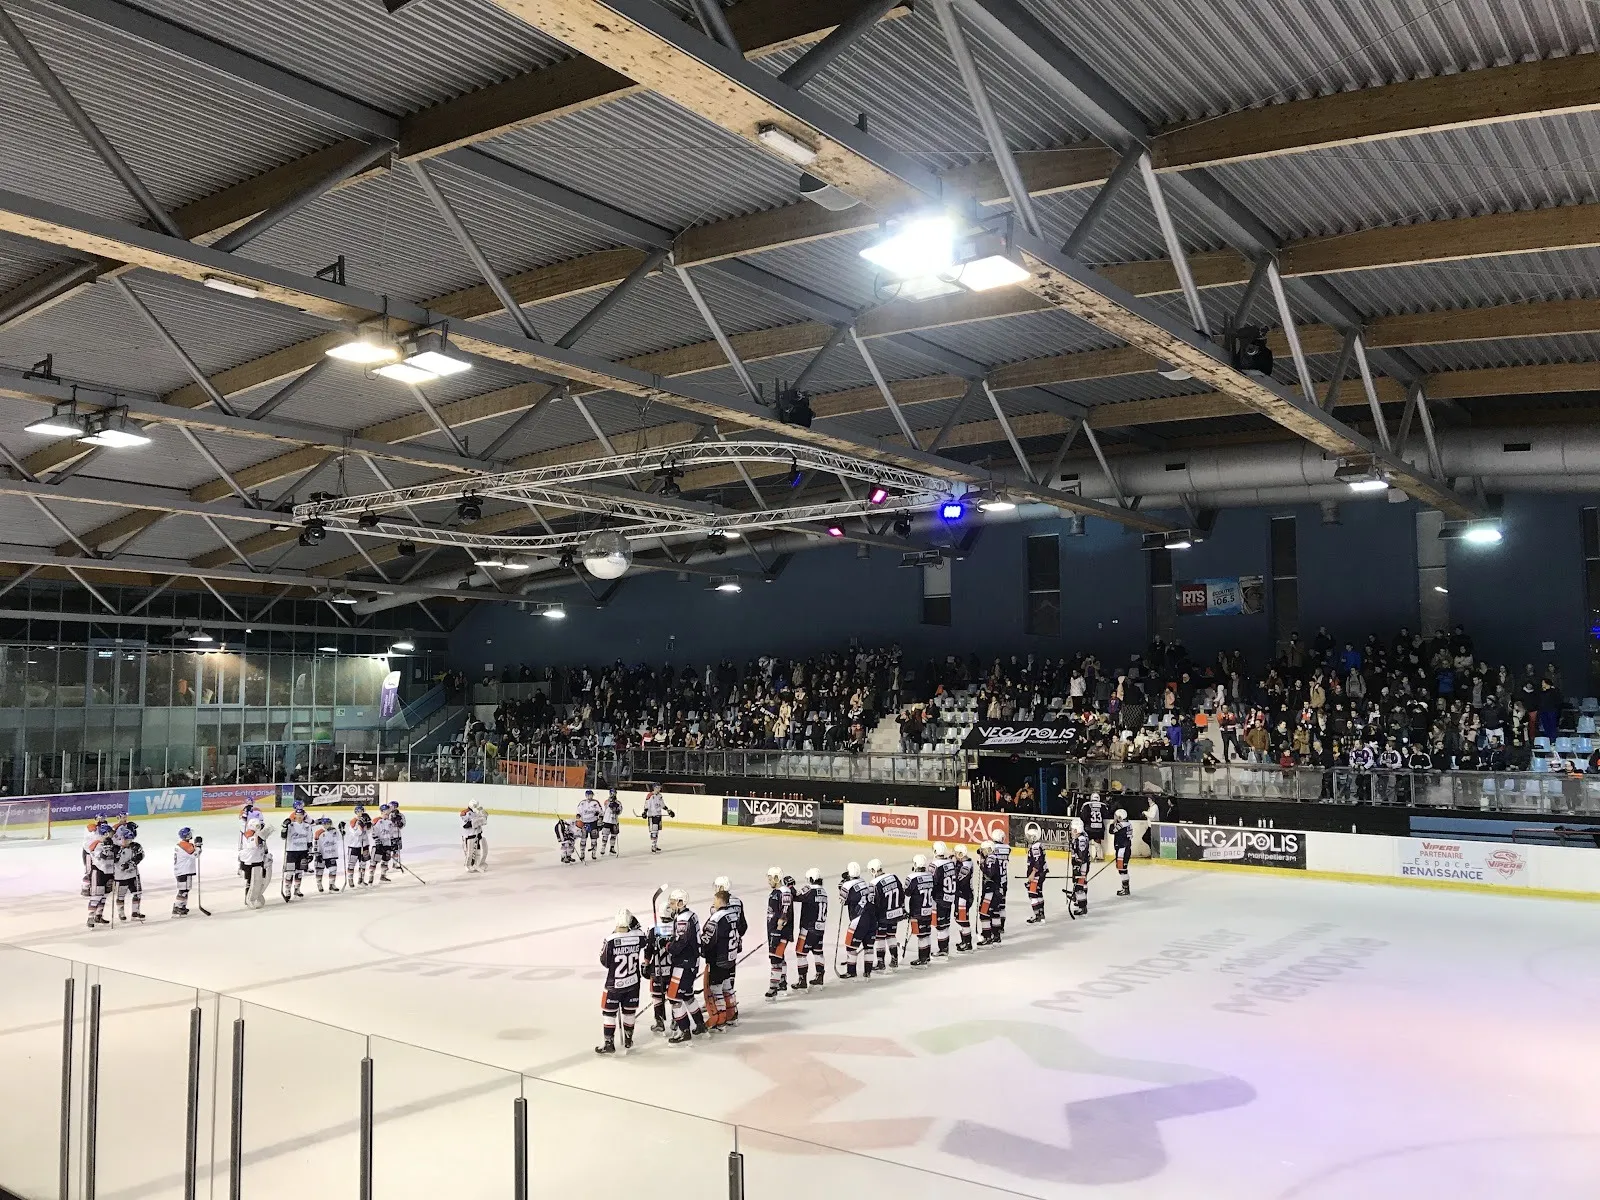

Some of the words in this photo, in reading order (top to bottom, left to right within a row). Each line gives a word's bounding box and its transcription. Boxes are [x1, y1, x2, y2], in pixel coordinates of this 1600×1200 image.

[1182, 590, 1206, 604] RTS
[1213, 595, 1235, 606] 106.5
[978, 726, 1076, 739] VEGAPOLIS
[202, 791, 232, 799] Espace
[299, 784, 375, 797] VEGAPOLIS
[743, 799, 814, 818] VEGAPOLIS
[871, 815, 887, 824] SUP
[895, 818, 916, 827] COM
[1090, 811, 1102, 823] 33
[932, 814, 1005, 844] IDRAC
[1182, 828, 1299, 853] VEGAPOLIS
[1419, 850, 1464, 860] PARTENAIRE
[1414, 857, 1471, 869] Espace
[1402, 866, 1484, 881] RENAISSANCE
[884, 887, 900, 911] 77
